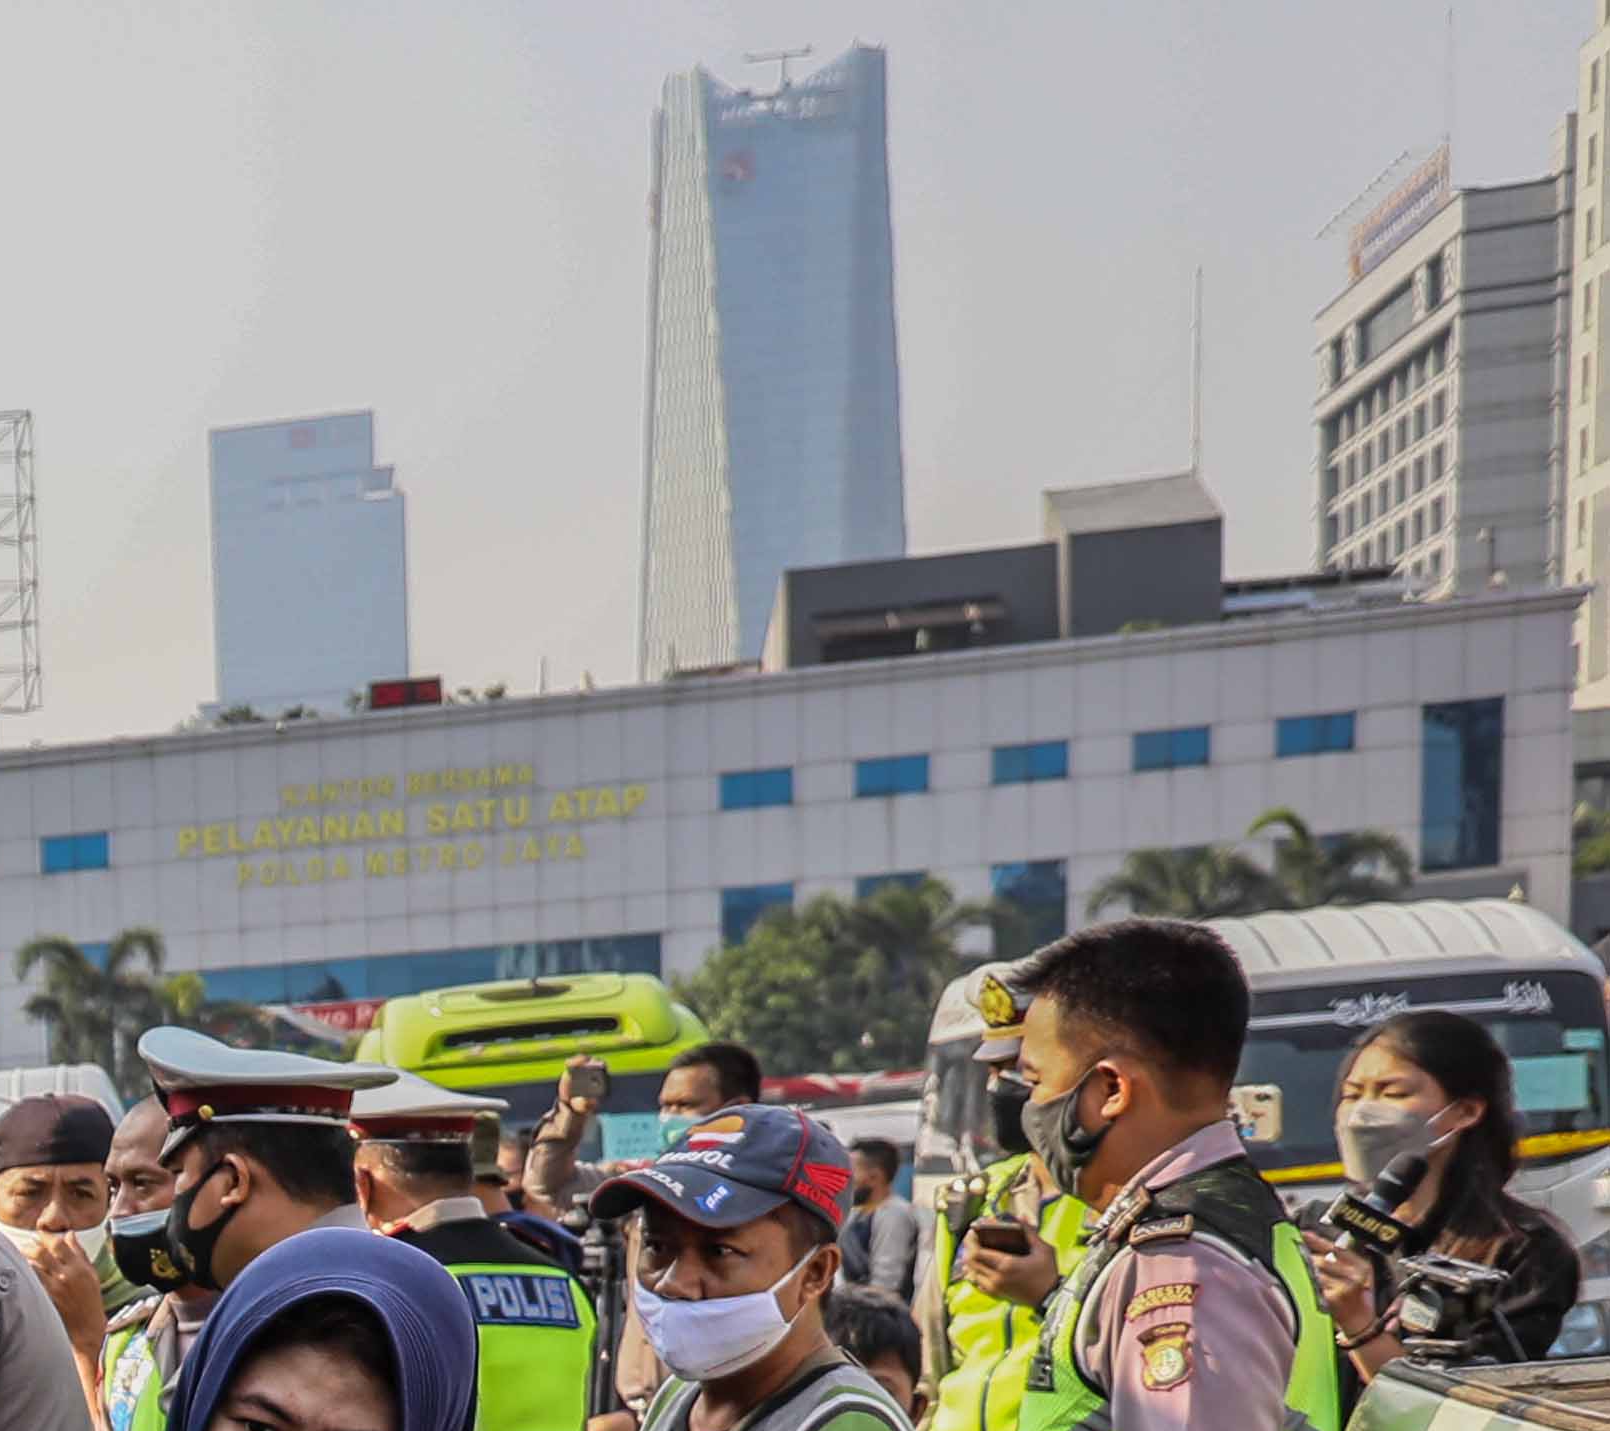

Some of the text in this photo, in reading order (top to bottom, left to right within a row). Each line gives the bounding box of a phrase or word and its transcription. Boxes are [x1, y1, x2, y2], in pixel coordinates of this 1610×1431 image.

[280, 763, 535, 807] KANTOR BERSAMA
[176, 785, 648, 856] PELAYANAN SATU ATAP
[236, 832, 586, 890] POLDA METRO JAYA
[469, 1275, 575, 1321] POLISI
